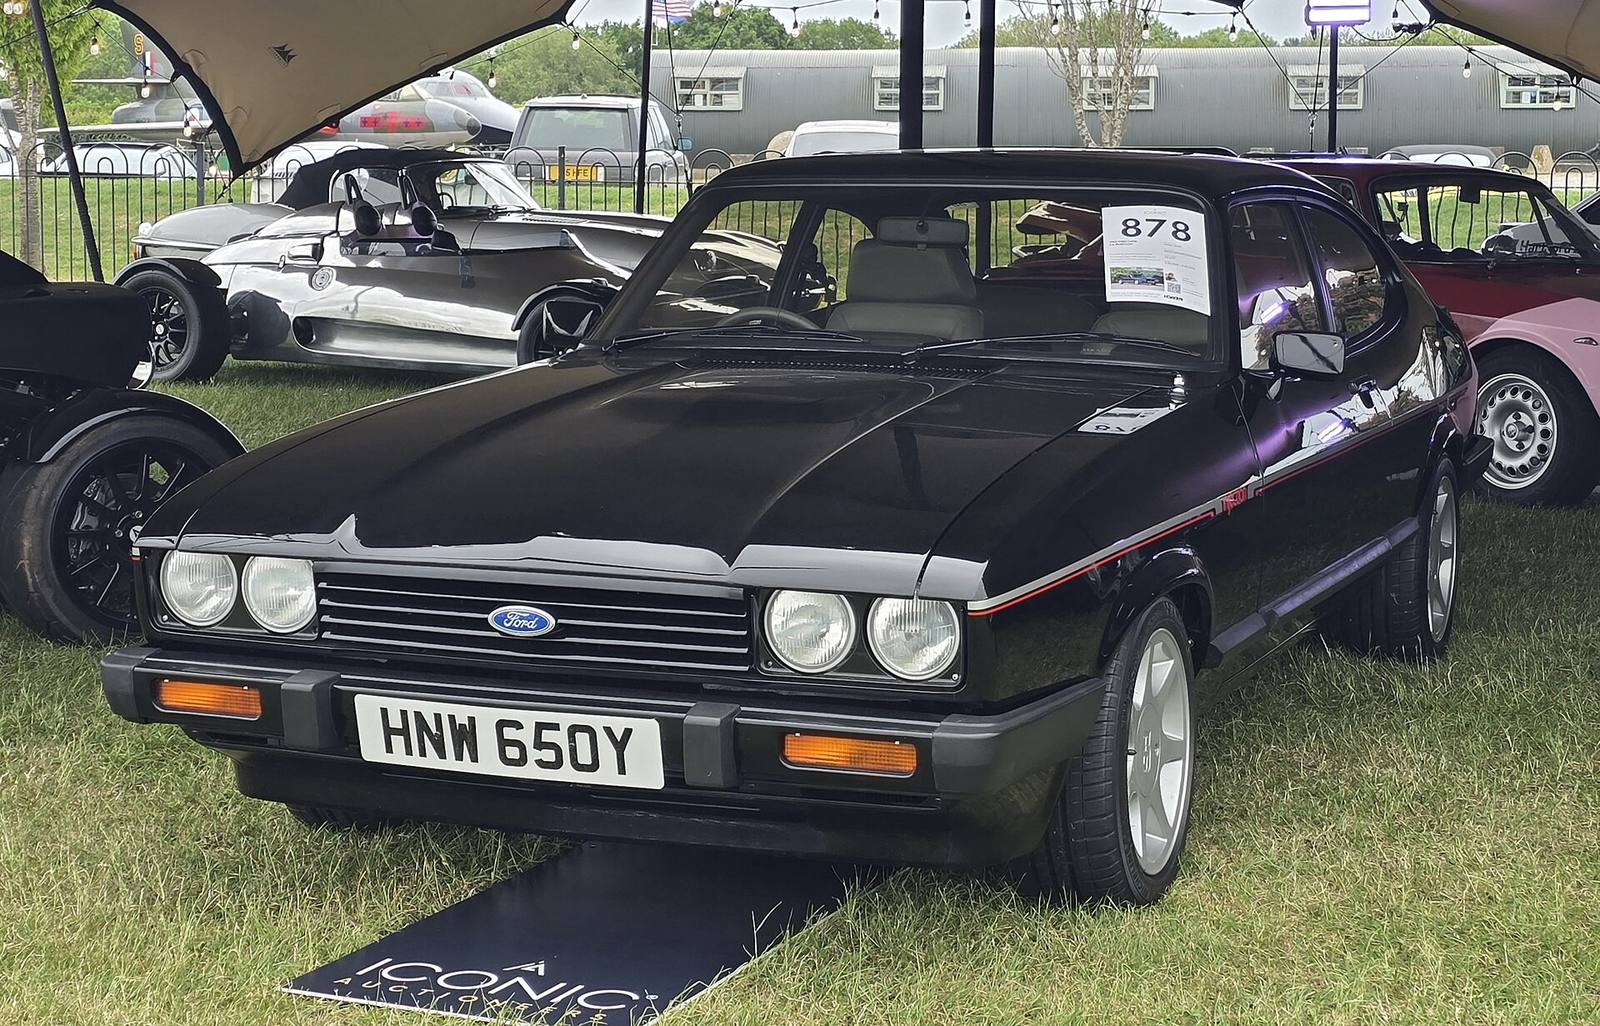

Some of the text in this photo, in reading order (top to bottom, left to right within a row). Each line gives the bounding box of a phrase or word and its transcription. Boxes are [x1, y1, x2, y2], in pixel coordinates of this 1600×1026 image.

[1121, 218, 1191, 242] 878
[503, 611, 538, 629] Ford
[379, 706, 633, 775] HNW 650Y
[356, 958, 640, 1010] ICONIC
